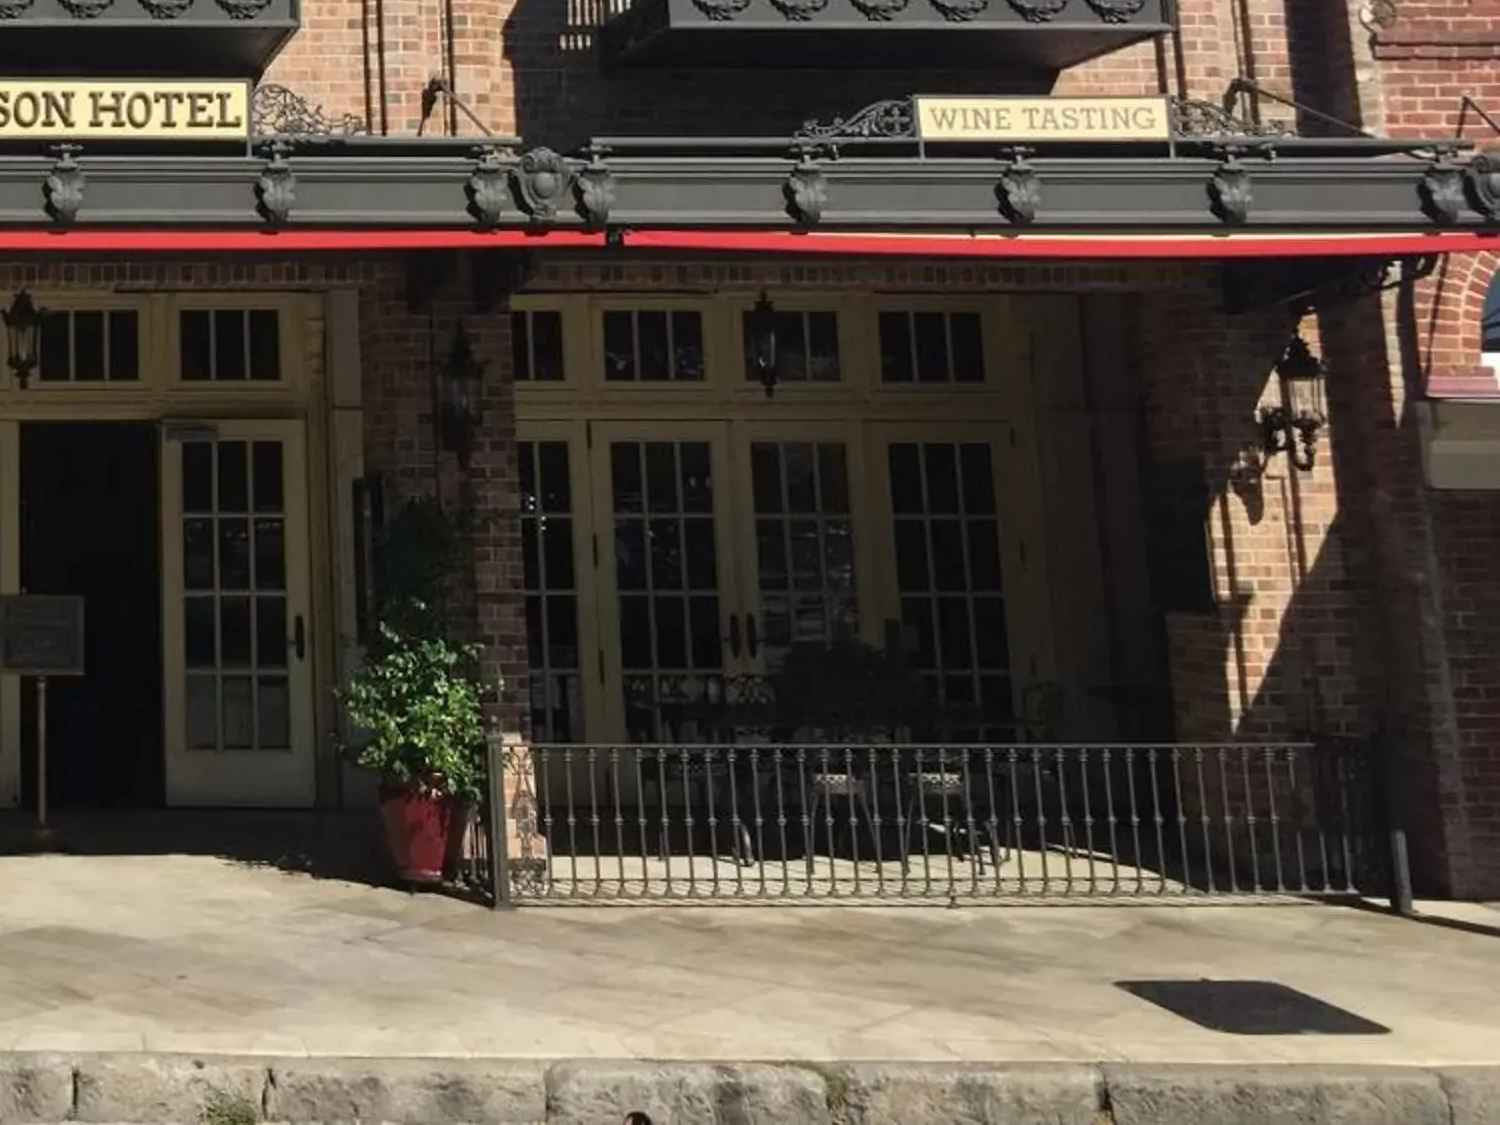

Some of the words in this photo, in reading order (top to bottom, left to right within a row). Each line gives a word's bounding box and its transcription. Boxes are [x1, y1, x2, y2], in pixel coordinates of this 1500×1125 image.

[88, 91, 242, 128] HOTEL
[929, 106, 1012, 131] WINE
[1021, 105, 1158, 131] TASTING
